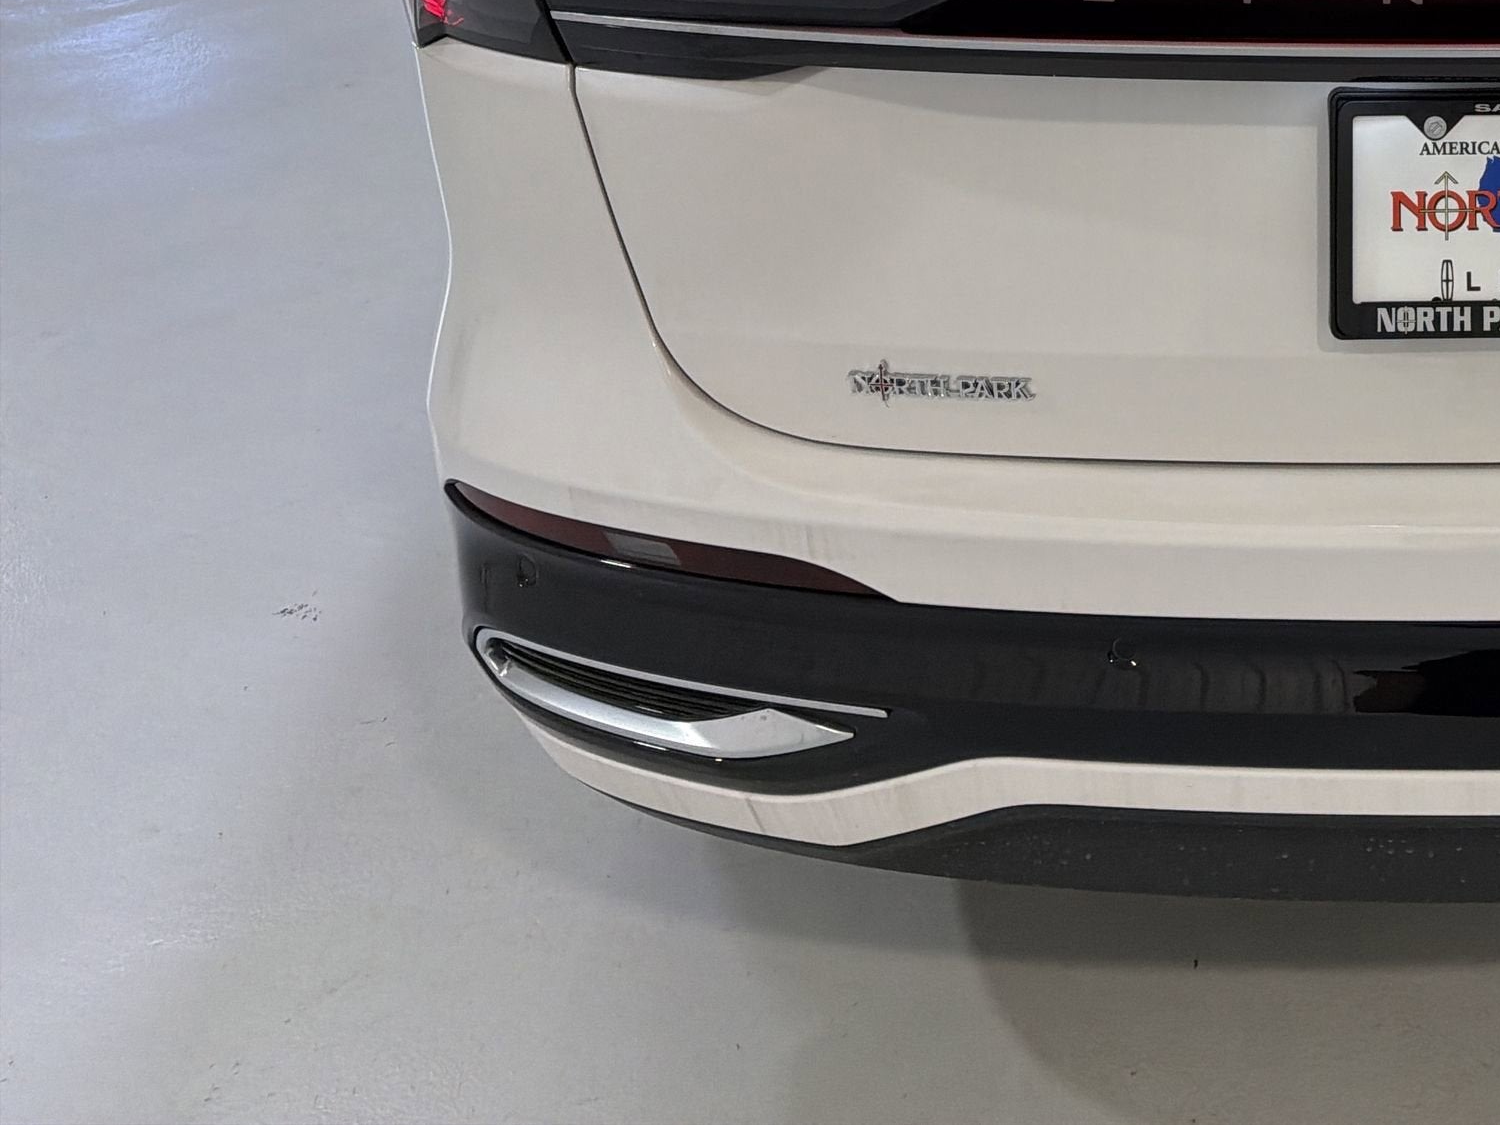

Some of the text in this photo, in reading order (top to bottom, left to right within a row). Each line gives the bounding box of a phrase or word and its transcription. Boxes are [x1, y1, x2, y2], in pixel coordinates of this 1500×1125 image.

[1376, 306, 1472, 333] NORTH
[849, 371, 1036, 401] NORTH PARK
